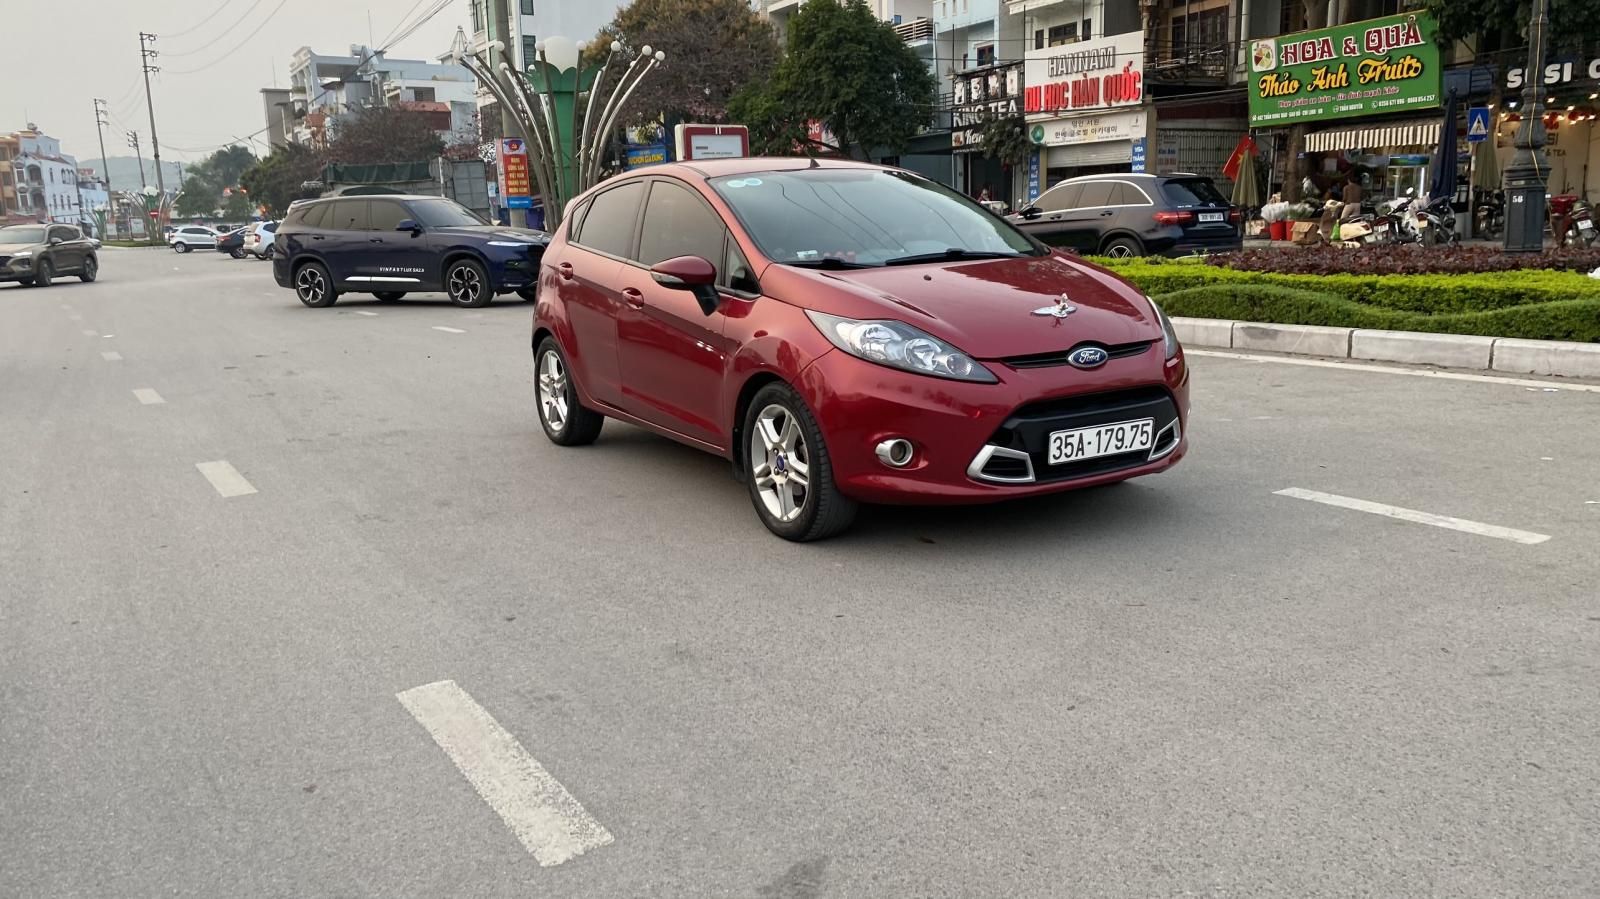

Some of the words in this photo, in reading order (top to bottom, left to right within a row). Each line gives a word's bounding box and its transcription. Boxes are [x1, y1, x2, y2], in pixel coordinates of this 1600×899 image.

[1282, 37, 1338, 66] HOA
[1343, 37, 1360, 57] &
[1365, 15, 1425, 56] QUẢ
[1048, 46, 1116, 77] HANNAM
[1507, 62, 1573, 88] SSI
[1025, 84, 1041, 113] DU
[1044, 81, 1069, 117] HỌC
[1072, 73, 1100, 108] HÀN
[1103, 61, 1141, 106] QUỐC
[1259, 72, 1300, 98] Thảo
[1307, 63, 1349, 91] Anh
[953, 105, 984, 127] KING
[989, 100, 1019, 121] TEA
[1079, 350, 1101, 364] Ford
[1052, 422, 1151, 460] 35A-179.75
